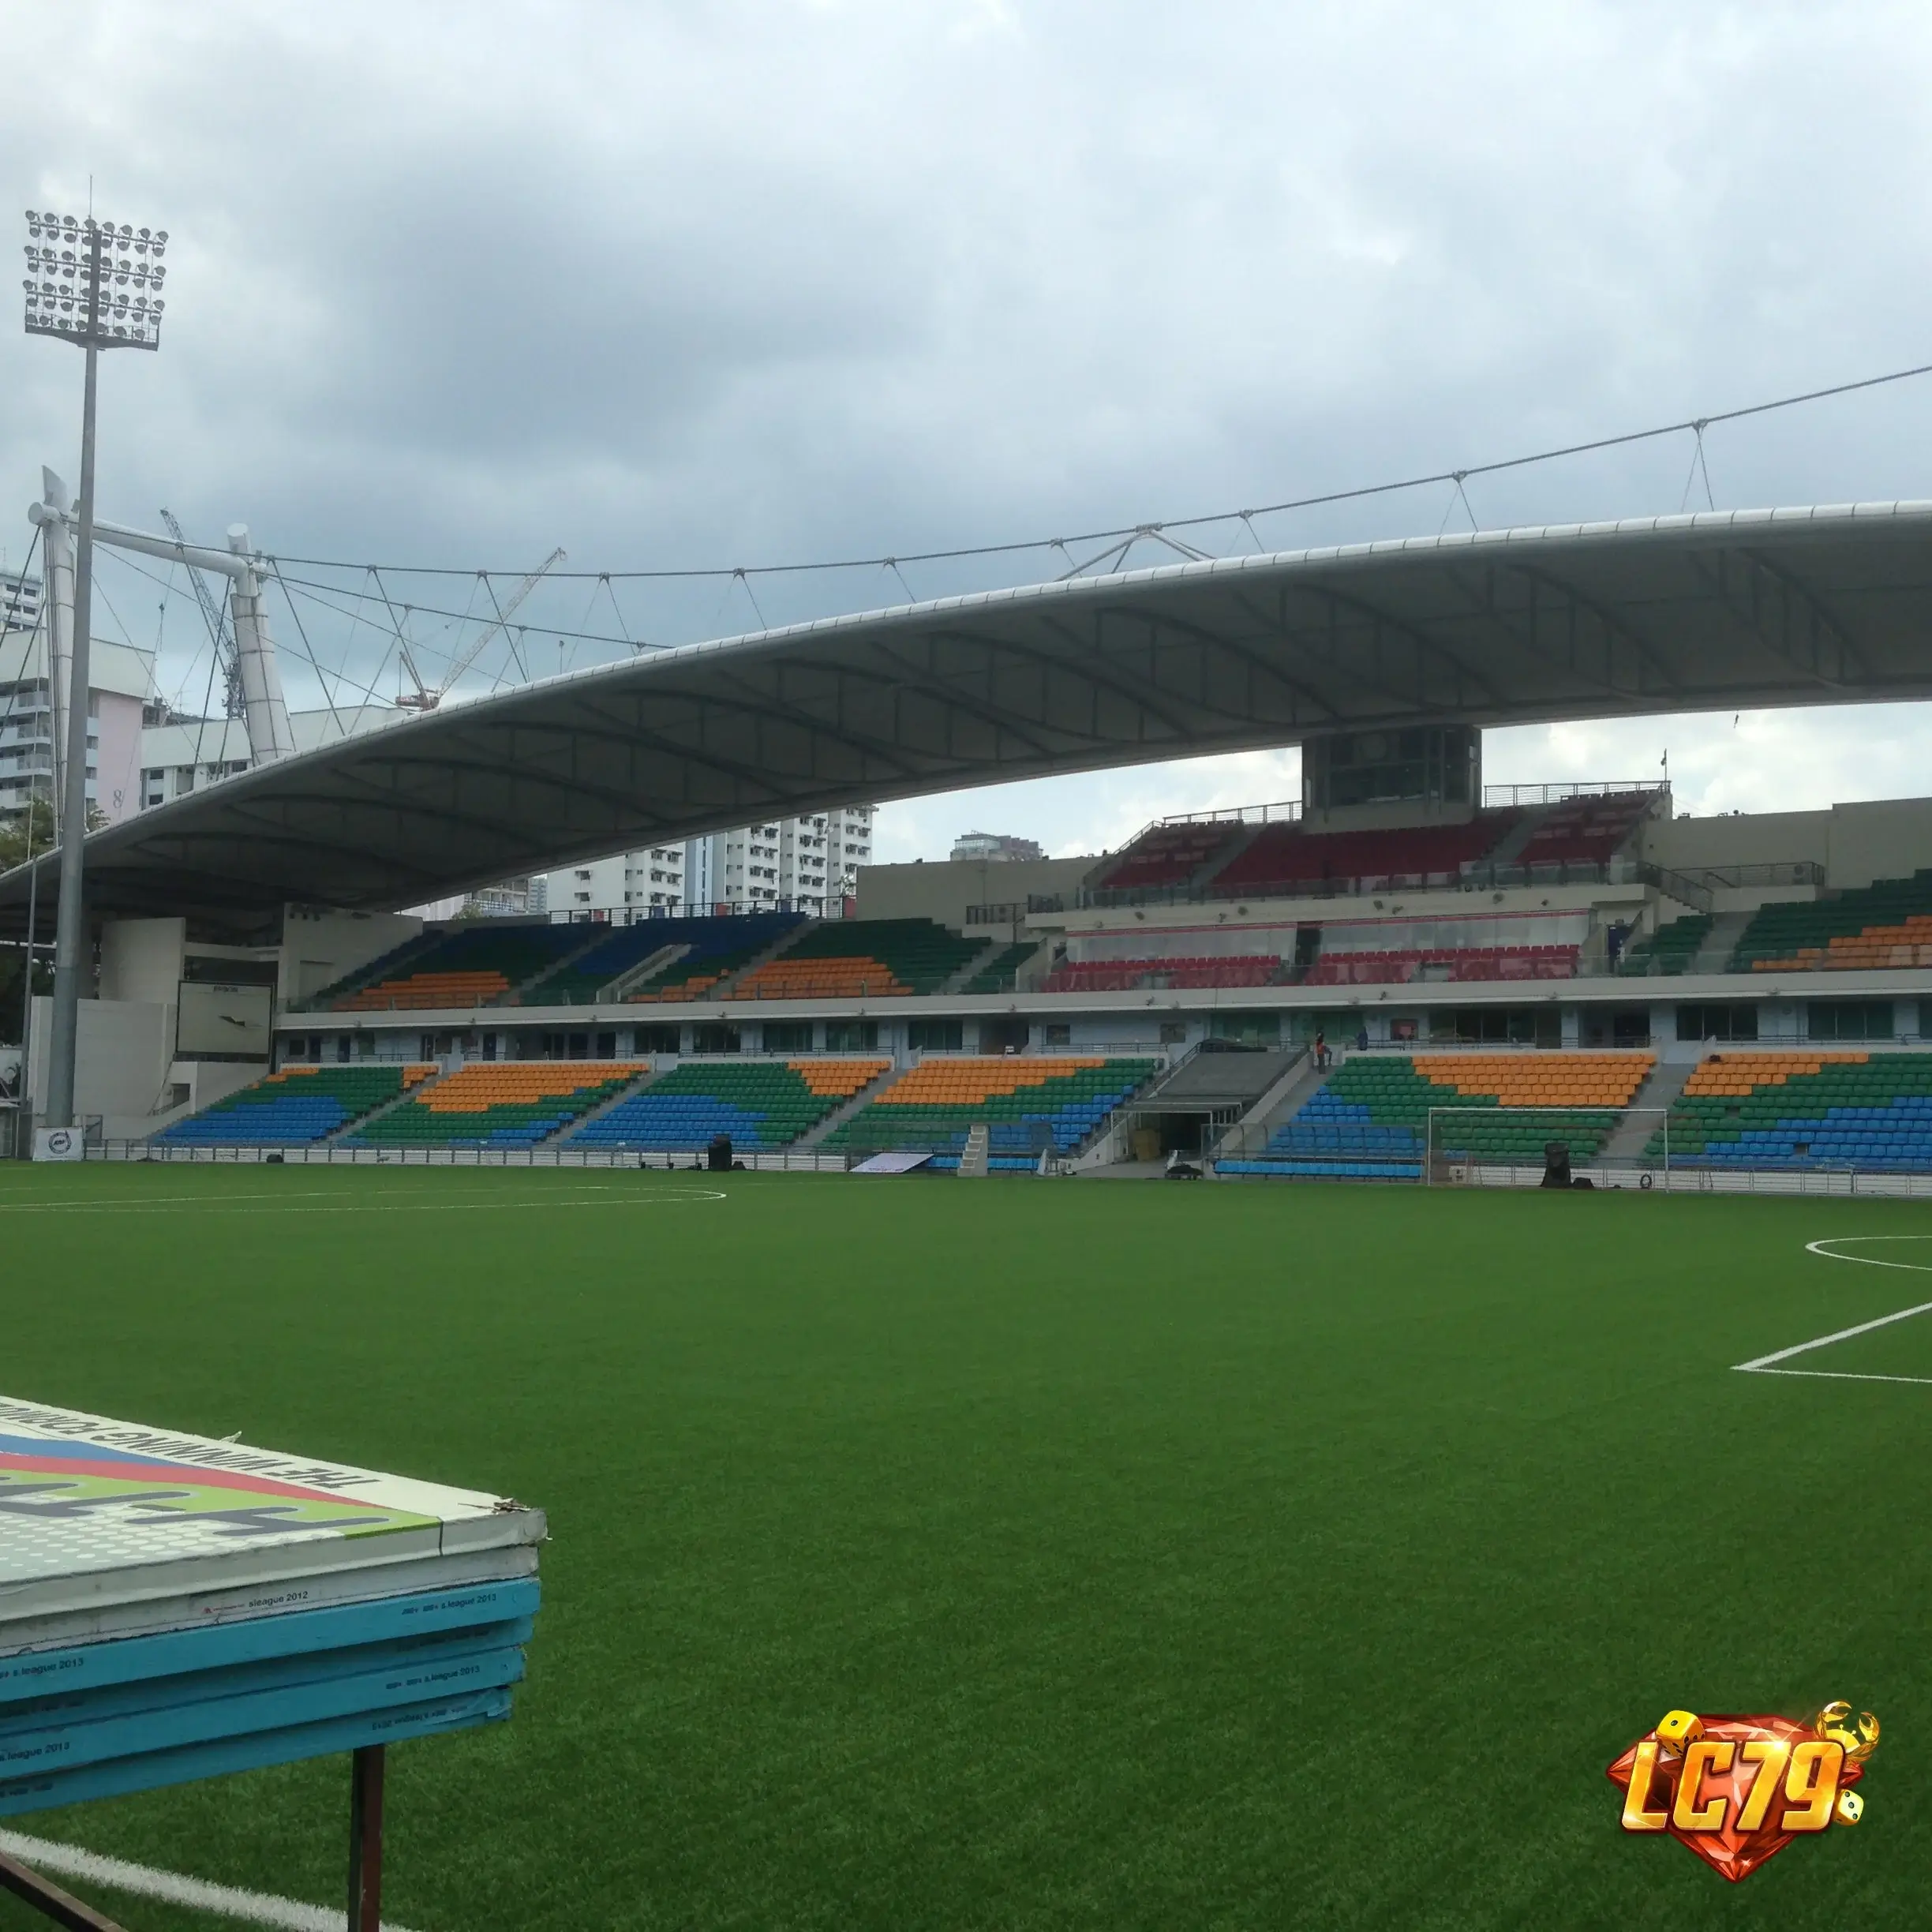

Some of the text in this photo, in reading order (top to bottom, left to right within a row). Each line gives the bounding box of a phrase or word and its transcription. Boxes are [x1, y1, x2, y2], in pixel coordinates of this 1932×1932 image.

[91, 1432, 294, 1470] WINNING
[262, 1467, 382, 1488] THE
[286, 1590, 309, 1602] 2012
[59, 1657, 84, 1670] 2013
